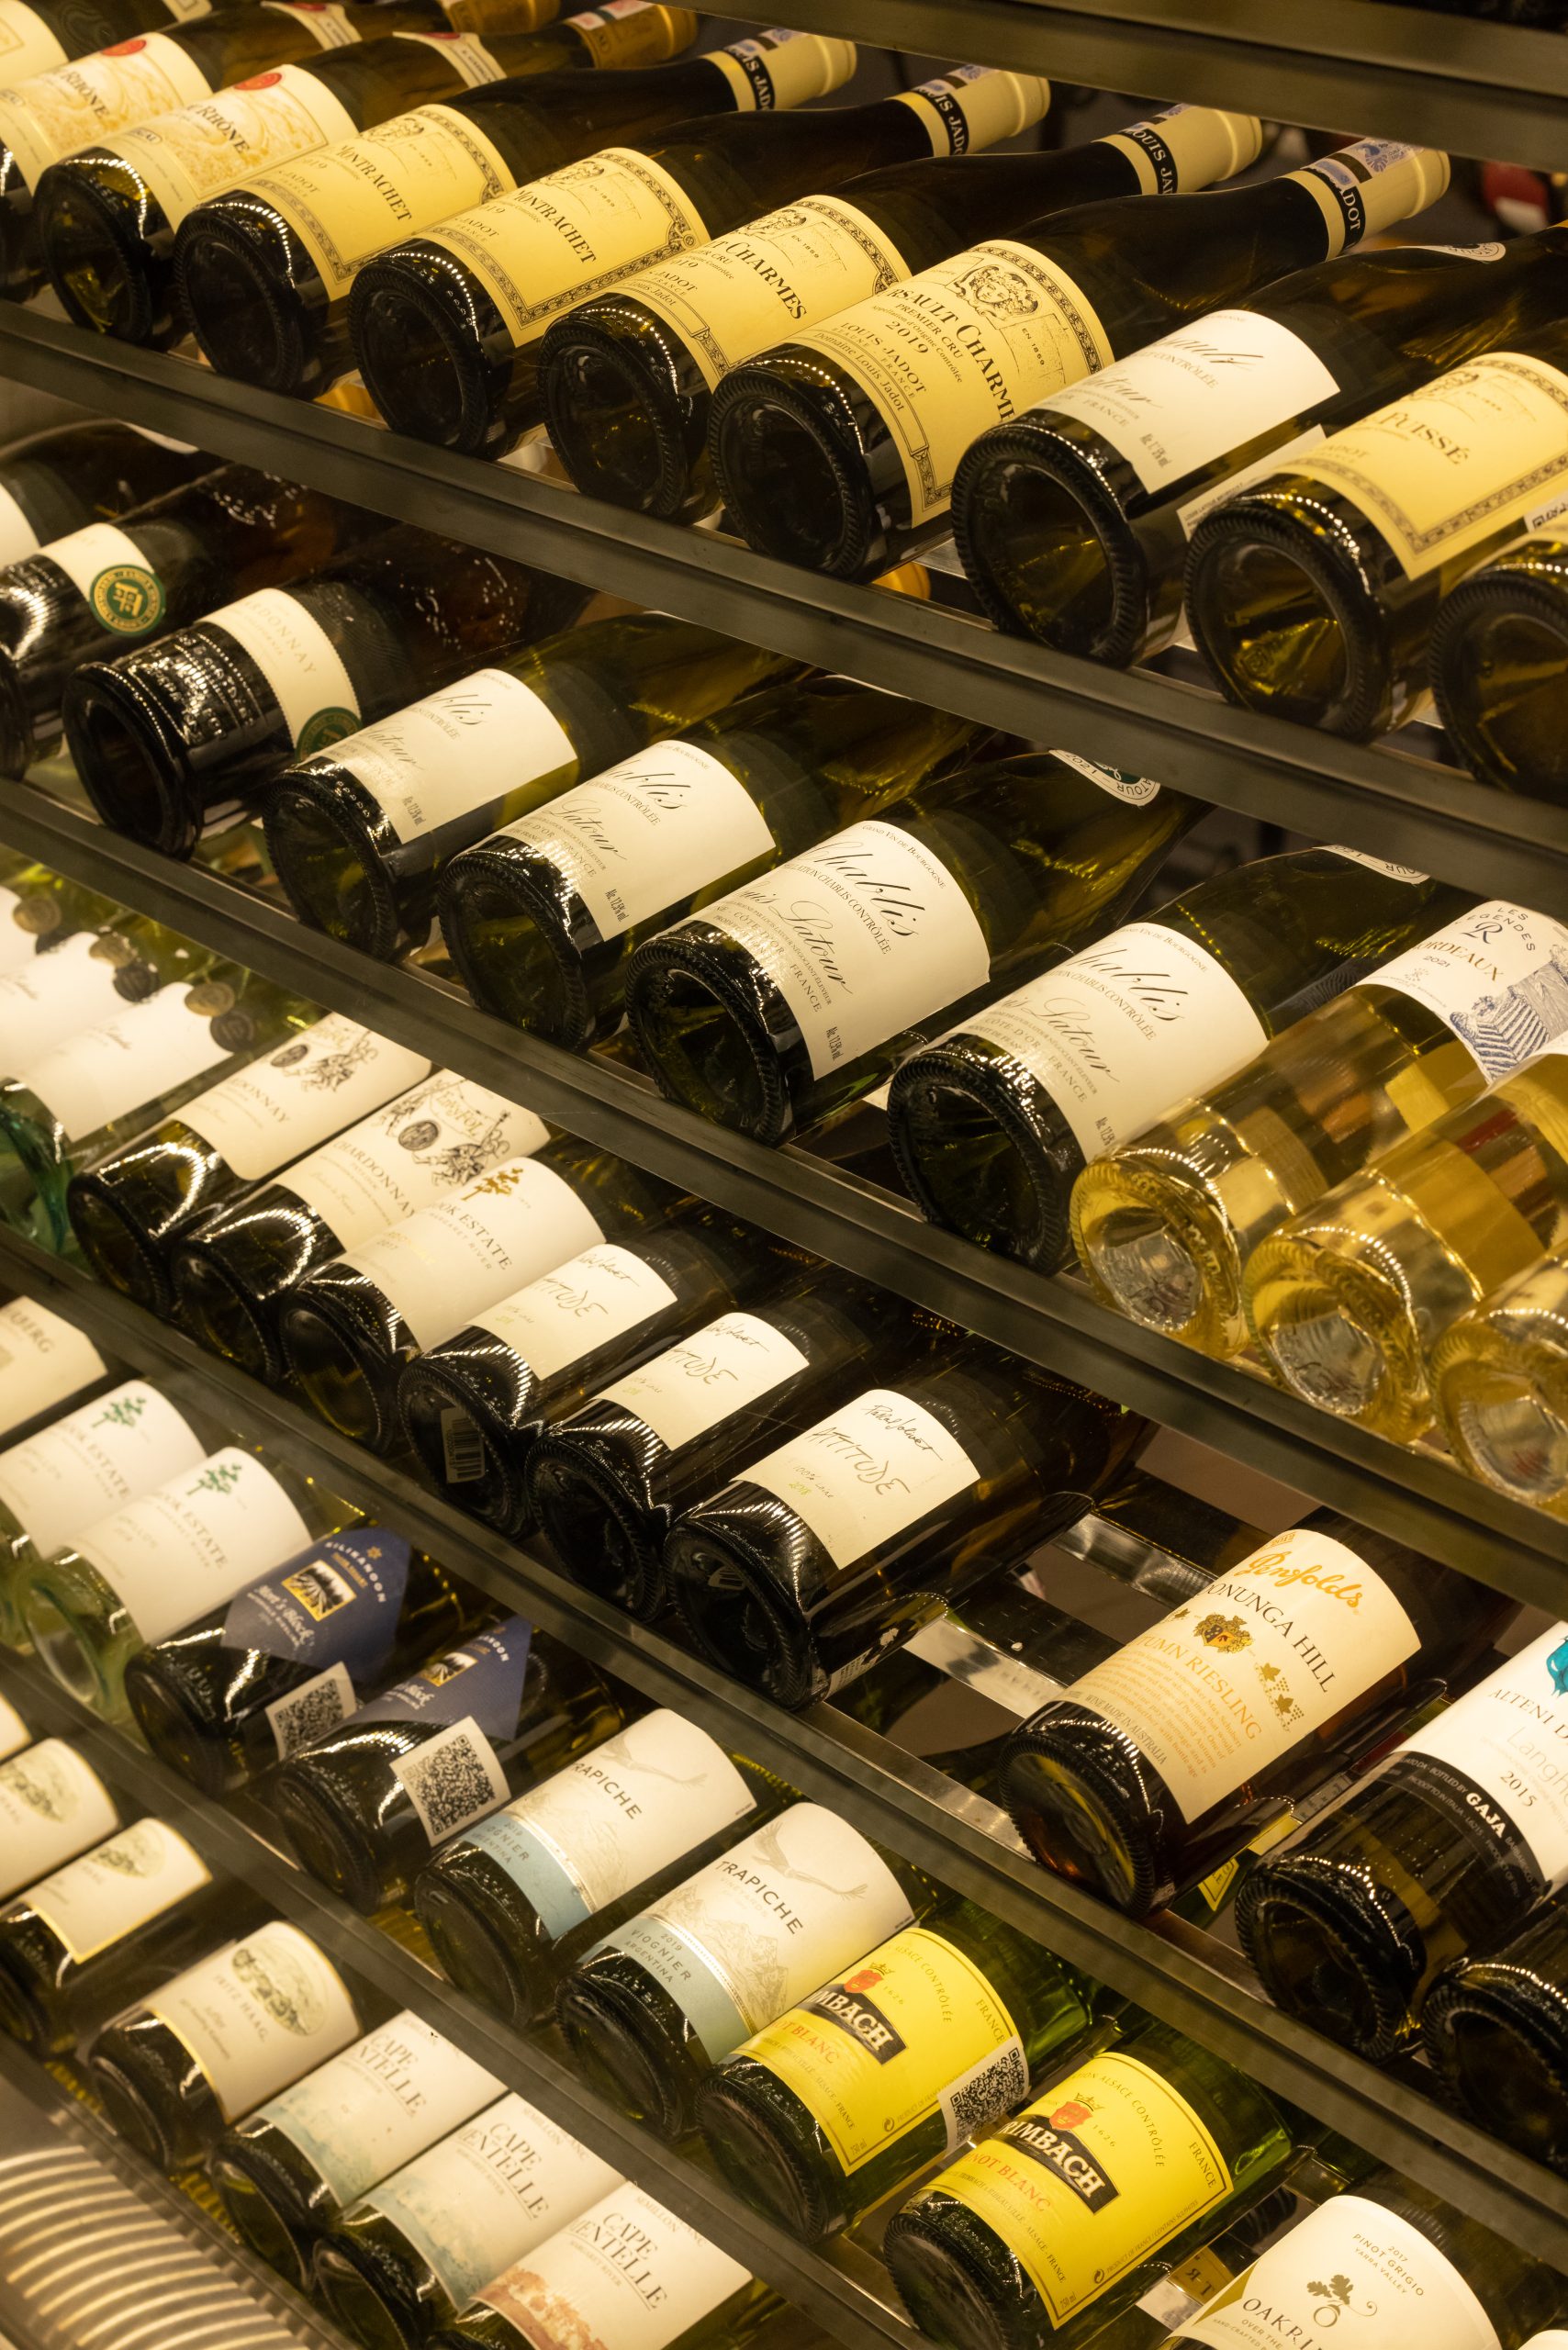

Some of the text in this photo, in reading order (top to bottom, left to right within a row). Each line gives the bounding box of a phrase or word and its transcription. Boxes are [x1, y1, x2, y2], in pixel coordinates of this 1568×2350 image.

[336, 145, 412, 221] MONTRACHET
[514, 190, 597, 263] MONTRACHET
[1343, 191, 1361, 230] DOT
[655, 270, 699, 292] JADOT
[726, 241, 808, 319] CHARMES
[840, 321, 927, 393] LOUIS JADOT
[885, 320, 930, 354] 2019
[885, 287, 958, 323] RSAULT
[956, 324, 1016, 423] CHARM
[895, 303, 964, 359] PREMIER CRU
[1021, 327, 1046, 366] EN 1859
[813, 332, 905, 412] Domaine Louis Jadot
[880, 356, 916, 398] FRANCE
[541, 798, 628, 861] Latour
[797, 840, 925, 937] Chablis
[906, 844, 946, 890] BOURGOGNE
[817, 873, 893, 956] CHABLIS CONTRÔLÉE
[1497, 907, 1529, 921] LES
[768, 900, 853, 995] Latour
[1419, 941, 1505, 981] ORDEAUX
[1423, 955, 1451, 968] 2021
[790, 963, 823, 1013] FRANCE
[1021, 996, 1122, 1083] Latour
[1104, 990, 1157, 1041] CONTRÔLÉE
[1047, 1055, 1089, 1104] FRANCE
[459, 1213, 513, 1271] ESTATE
[803, 1427, 912, 1495] ATTITUDE
[1234, 1550, 1363, 1608] Penfolds
[1202, 1582, 1339, 1694] ONUNGA HILL
[1185, 1654, 1263, 1741] RIESLING
[1488, 1689, 1555, 1724] ALTENI
[1103, 1703, 1126, 1720] MADE
[1130, 1725, 1168, 1765] AUSTRALIA
[1429, 1766, 1460, 1788] BOTTLED
[1465, 1792, 1506, 1839] GAJA
[1499, 1770, 1538, 1807] 2015
[715, 1860, 804, 1935] TRAPICHE
[623, 1940, 675, 1985] ARGENTINA
[631, 1929, 693, 1983] VIOGNIER
[658, 1932, 683, 1953] 2019
[809, 1987, 895, 2052] IMBACH
[920, 1962, 953, 2023] CONTRÔLÉE
[790, 2023, 840, 2065] BLANC
[975, 1998, 1005, 2044] FRANCE
[489, 2121, 542, 2172] CAPE
[1092, 2123, 1117, 2148] 1626
[1099, 2074, 1166, 2168] ALSACE CONTRÔLÉE
[458, 2126, 551, 2219] ENTELLE
[995, 2120, 1107, 2199] RIMBACH
[1188, 2141, 1217, 2189] FRANCE
[997, 2162, 1051, 2212] BLANC
[603, 2211, 659, 2261] CAPE
[1027, 2226, 1067, 2284] ALSACE FRANCE
[1386, 2244, 1409, 2263] 2017
[1352, 2232, 1425, 2297] PINOT GRIGIO
[1354, 2246, 1408, 2295] YARRA VALLEY
[1241, 2318, 1284, 2350] OVER THE
[1242, 2297, 1324, 2350] OAKRI
